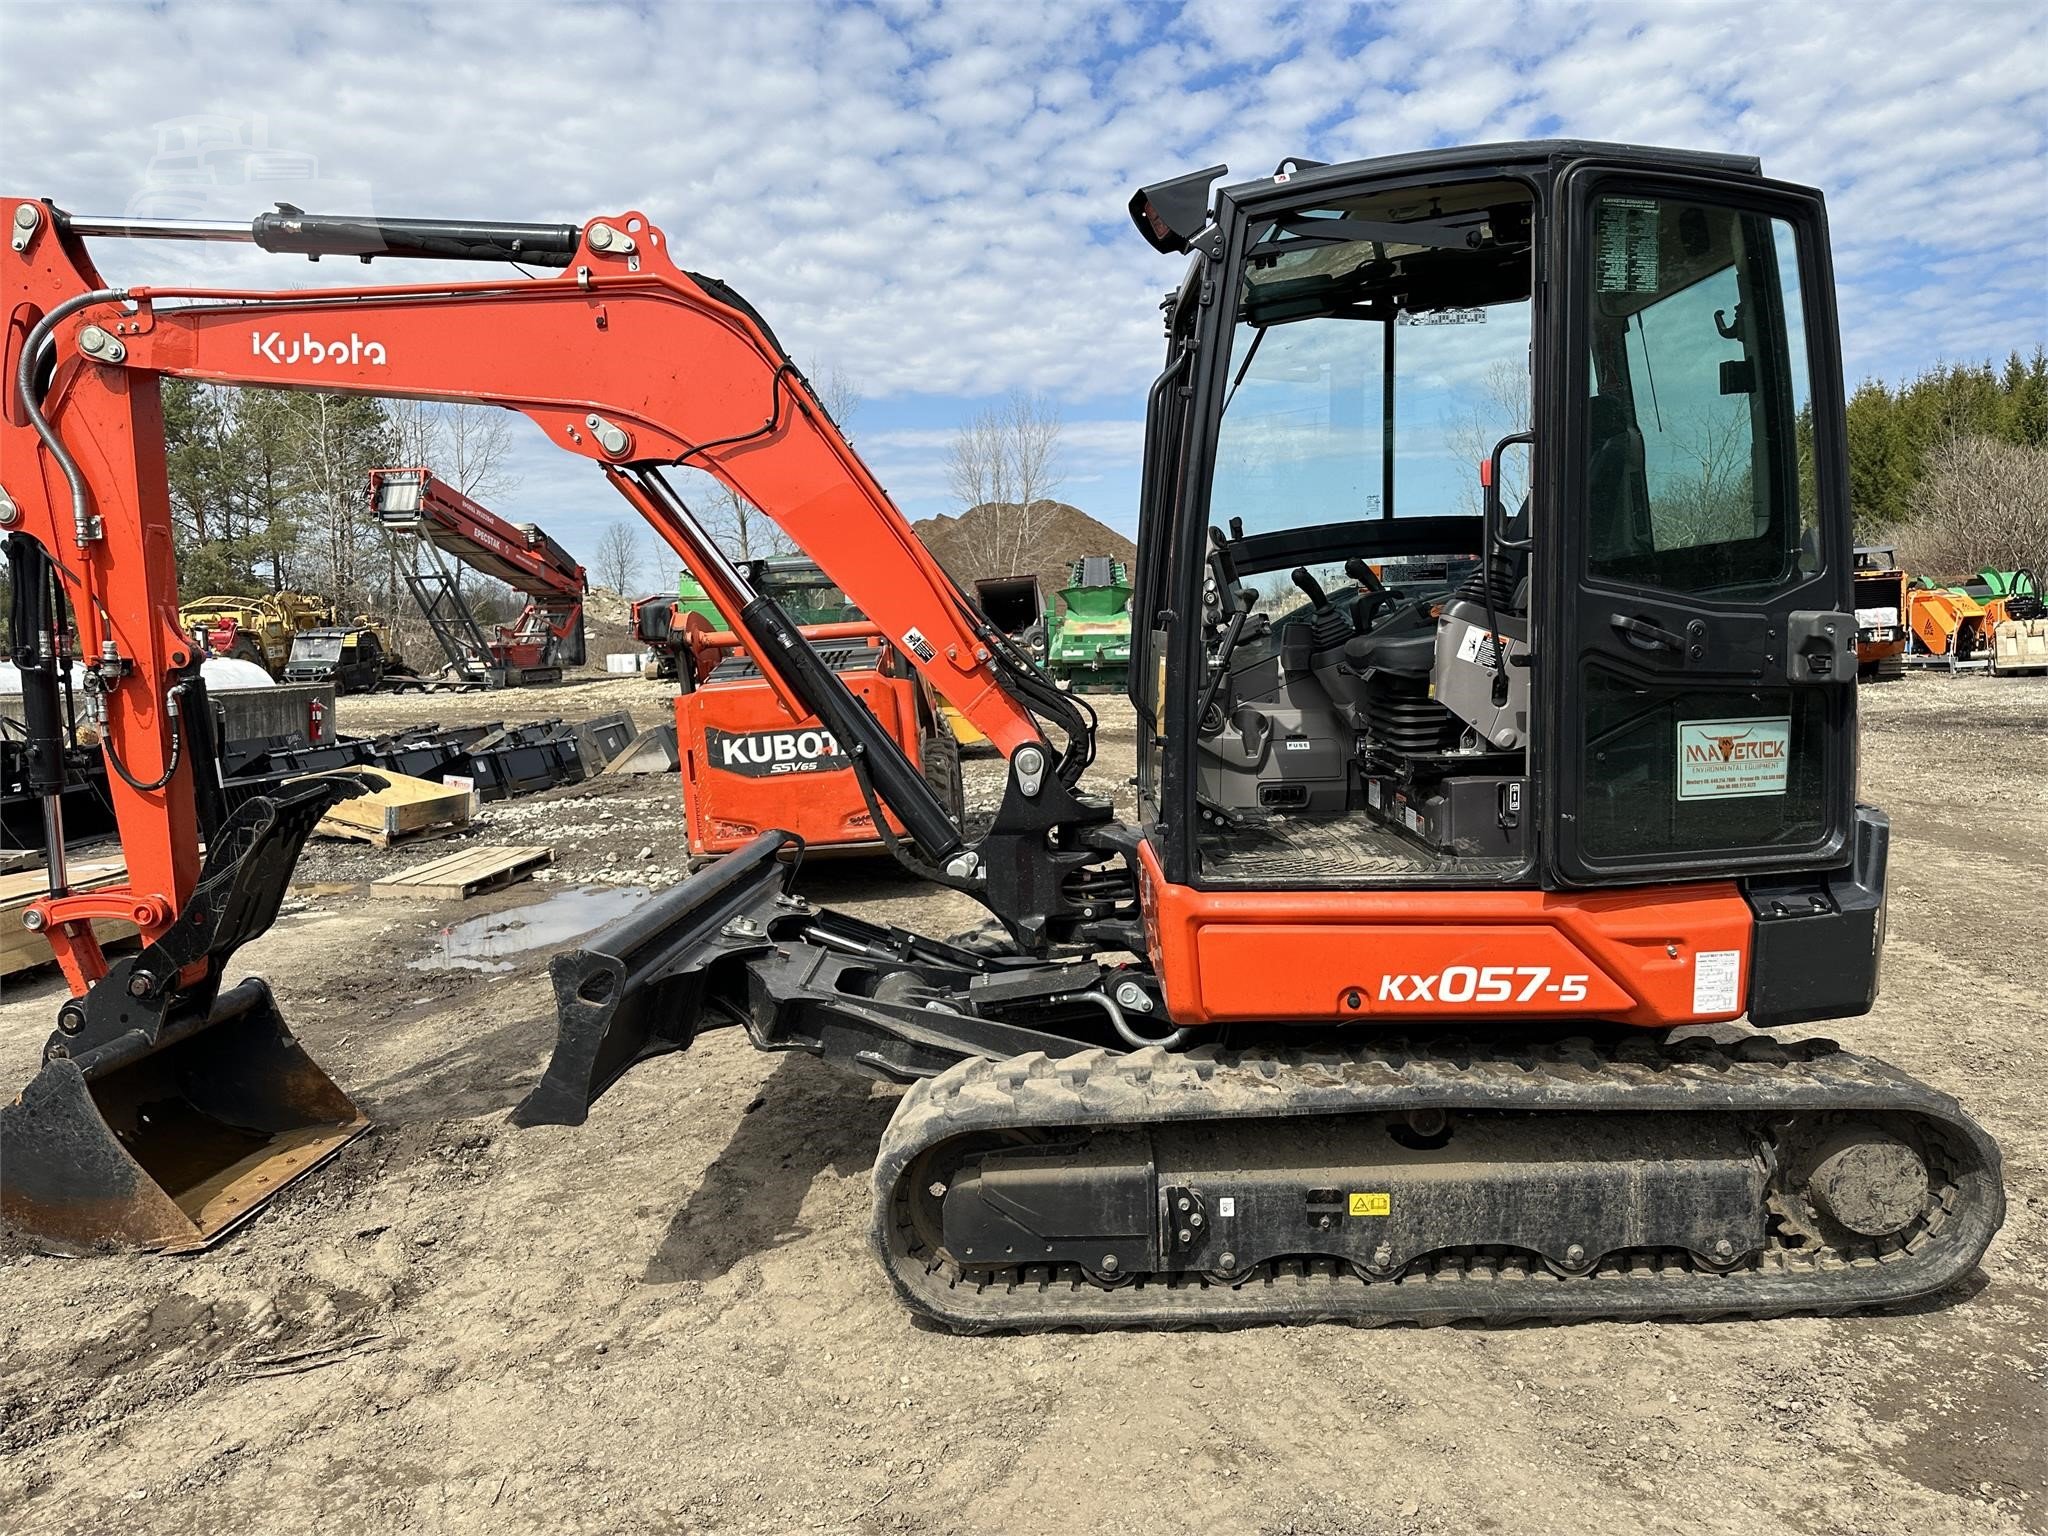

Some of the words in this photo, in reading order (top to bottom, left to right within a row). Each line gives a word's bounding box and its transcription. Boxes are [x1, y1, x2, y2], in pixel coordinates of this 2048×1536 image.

[252, 331, 387, 365] Kubota
[721, 730, 848, 765] KUBOT
[1686, 741, 1784, 762] MAVERICK
[770, 761, 818, 774] SSV65
[1692, 764, 1743, 774] ENVIRONMENTAL
[1744, 762, 1780, 770] EQUIPMENT
[1378, 966, 1589, 1002] KX057-5
